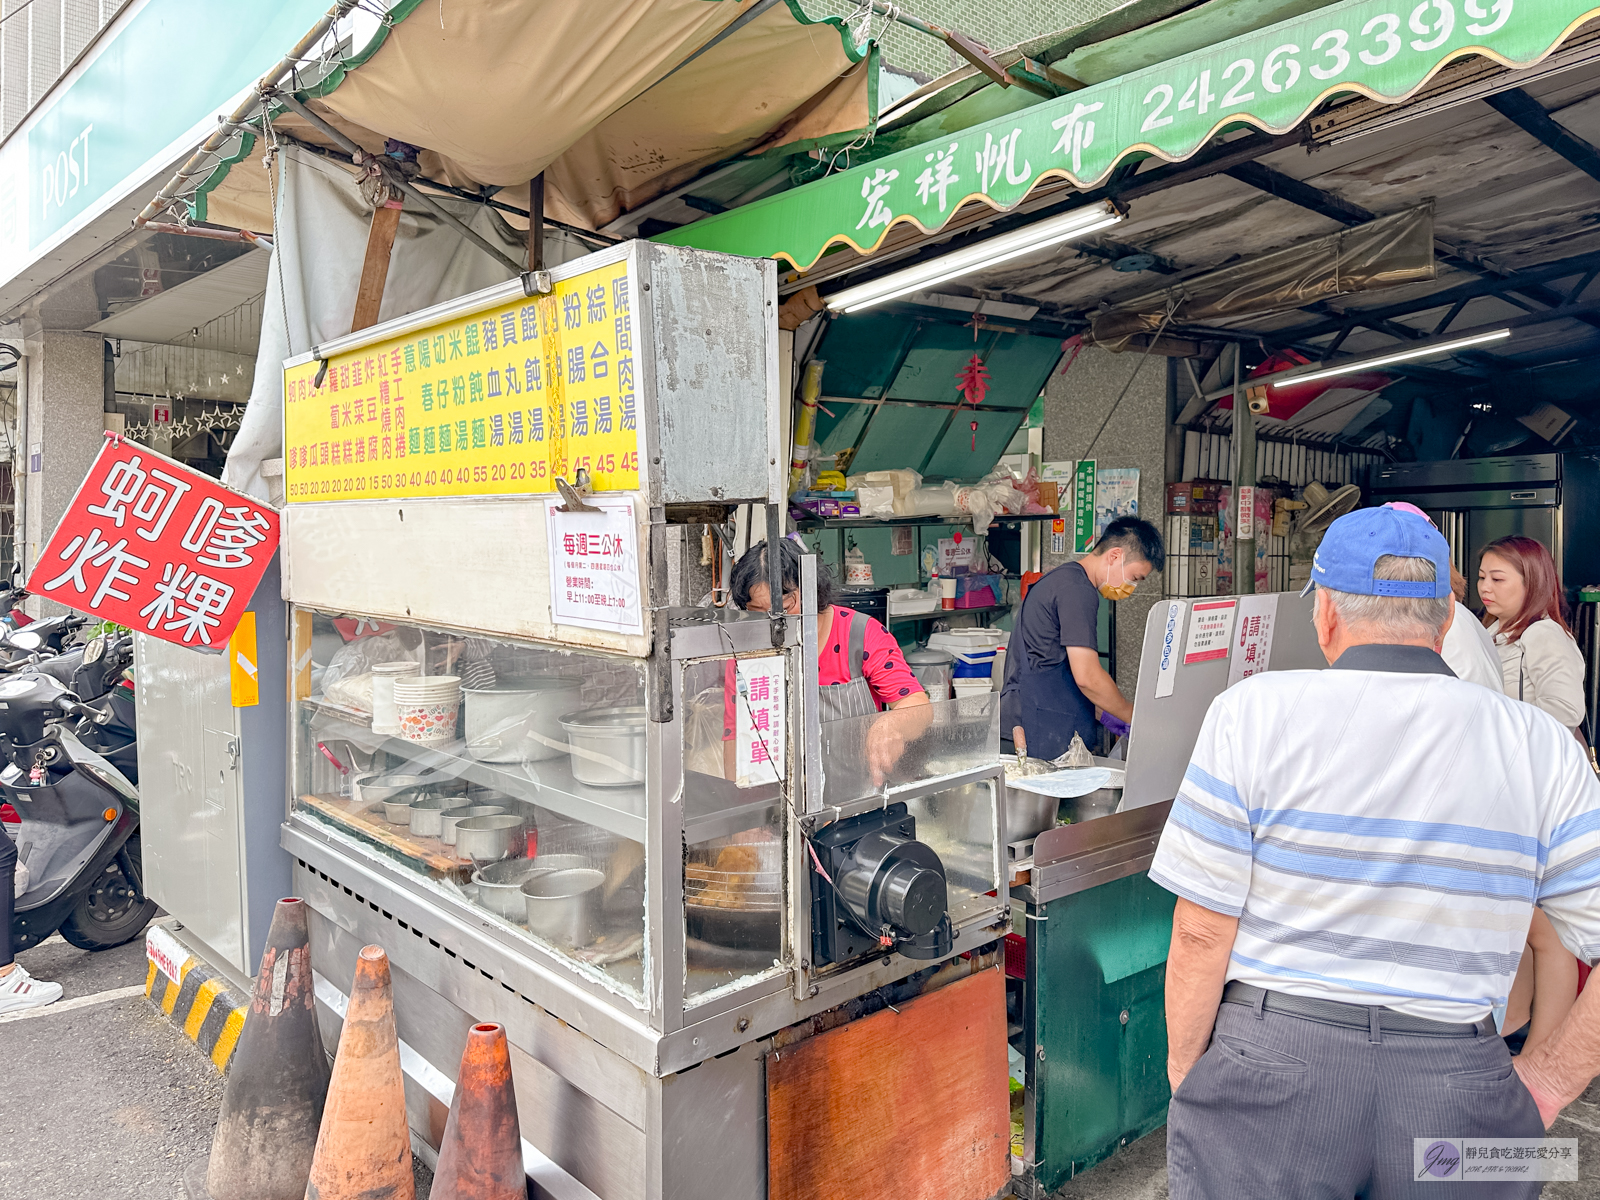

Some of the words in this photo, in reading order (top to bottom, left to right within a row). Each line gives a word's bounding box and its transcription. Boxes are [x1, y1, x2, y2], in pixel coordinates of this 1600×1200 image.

[1140, 0, 1513, 132] 24263399
[43, 123, 93, 221] POST
[855, 101, 1104, 230] 宏祥帆布
[562, 291, 588, 437] 粉腸湯
[586, 284, 612, 435] 綜合湯
[612, 275, 636, 431] 隔間肉湯
[465, 323, 486, 450] 餛飩麵
[482, 318, 504, 447] 豬血湯
[501, 311, 523, 445] 貢丸湯
[520, 305, 544, 443] 餛飩湯
[404, 343, 420, 455] 意麵
[418, 338, 435, 455] 陽春麵
[433, 334, 451, 453] 切仔麵
[449, 329, 468, 451] 米粉湯
[340, 363, 353, 464] 甜米糕
[365, 356, 378, 462] 炸豆腐
[377, 353, 391, 460] 紅糟燒肉
[391, 347, 406, 459] 手工肉捲
[329, 367, 341, 466] 蘿蔔糕
[473, 466, 487, 482] 55
[491, 464, 506, 481] 20
[510, 462, 525, 480] 20
[530, 460, 546, 479] 35
[573, 456, 591, 475] 45
[596, 454, 615, 474] 45
[621, 451, 639, 472] 45
[310, 481, 319, 495] 20
[321, 480, 329, 494] 20
[332, 479, 341, 493] 20
[343, 478, 353, 492] 20
[356, 477, 366, 491] 20
[369, 476, 379, 490] 15
[381, 474, 392, 489] 50
[395, 473, 406, 488] 30
[410, 471, 421, 488] 40
[425, 470, 437, 486] 40
[440, 469, 453, 485] 40
[456, 467, 469, 484] 40
[290, 484, 298, 496] 50
[300, 482, 308, 496] 50
[563, 533, 623, 558] 每週三公休
[43, 527, 235, 645] 炸粿
[750, 675, 770, 764] 請填單
